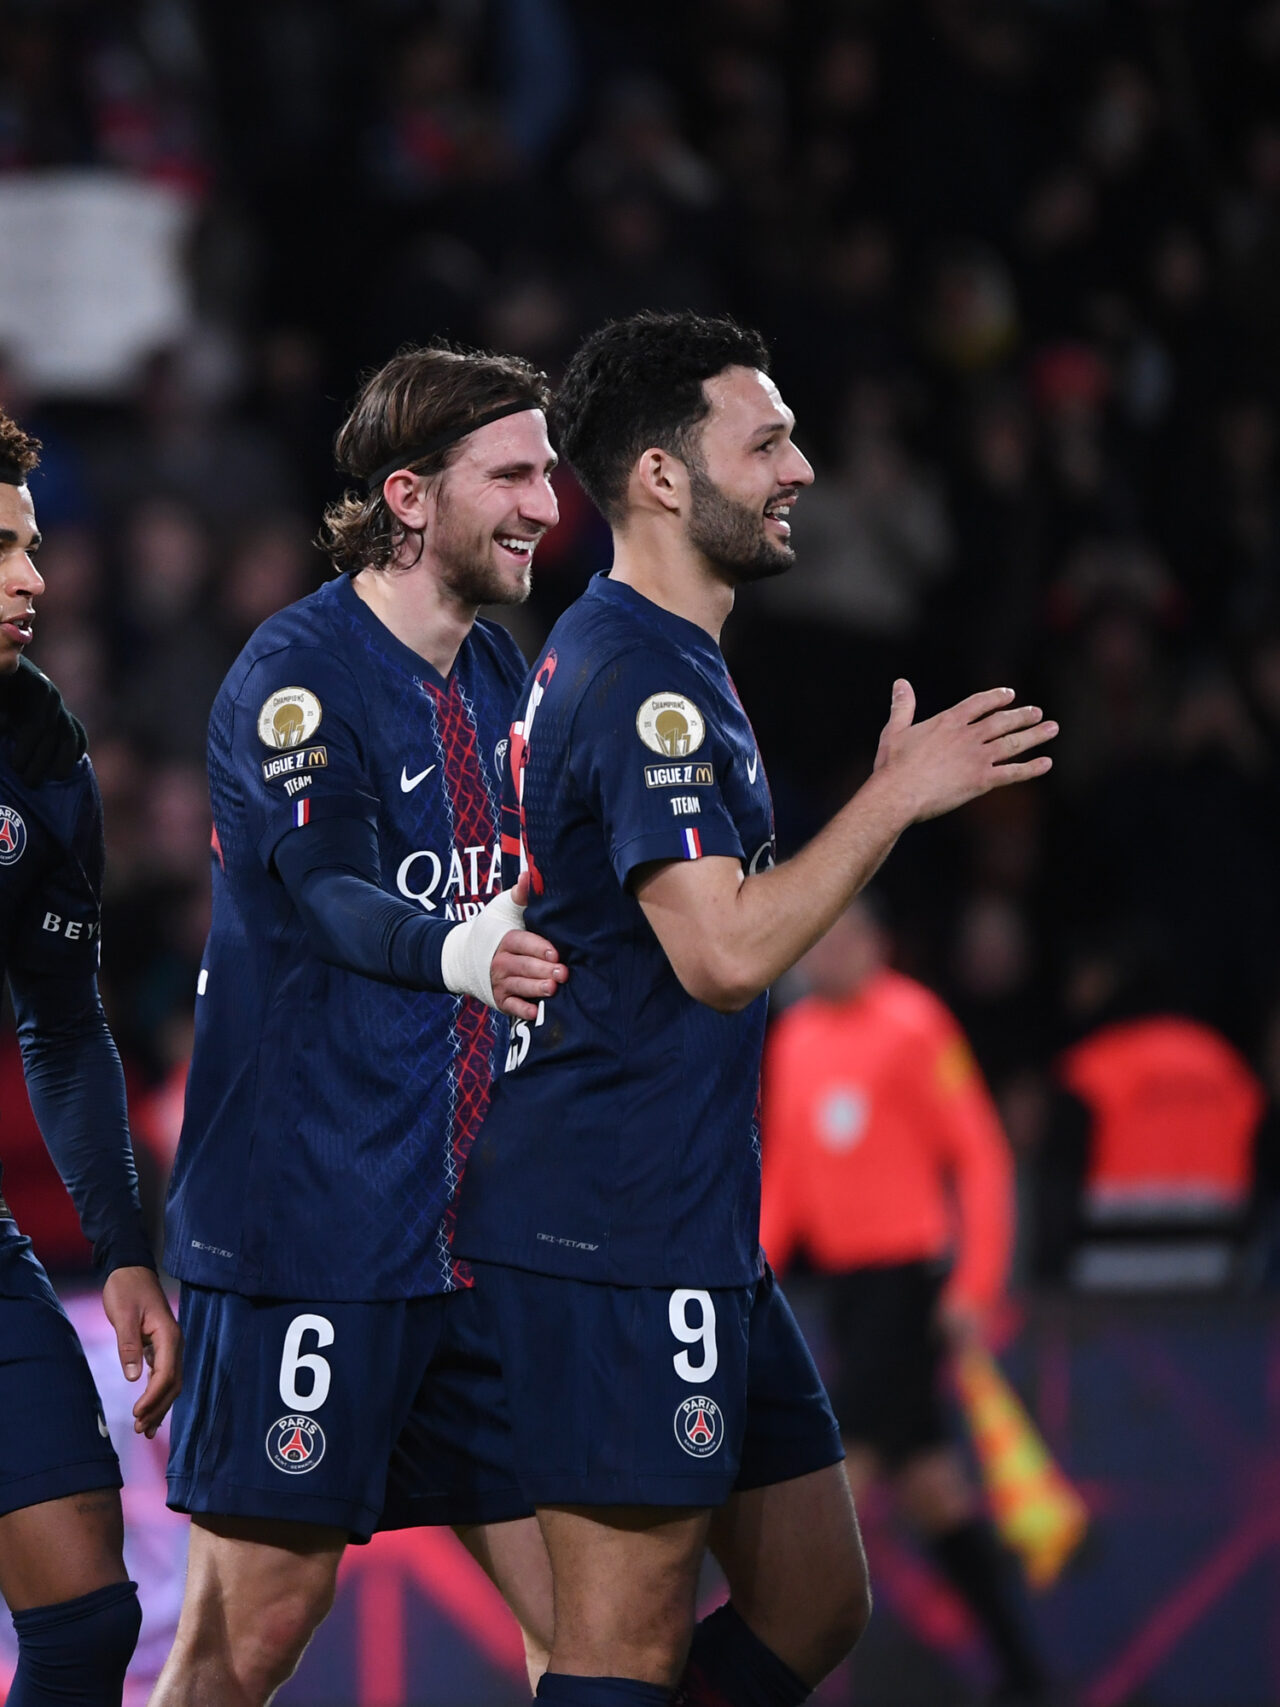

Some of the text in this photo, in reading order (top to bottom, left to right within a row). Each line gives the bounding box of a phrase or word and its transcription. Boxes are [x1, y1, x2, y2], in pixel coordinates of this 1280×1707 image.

[263, 756, 295, 779] LIGUE
[647, 767, 682, 786] LIGUE
[396, 843, 502, 912] QATA
[42, 910, 101, 940] BEY
[668, 1288, 718, 1383] 9
[278, 1313, 335, 1412] 6
[682, 1399, 717, 1415] PARIS
[279, 1418, 317, 1434] PARIS
